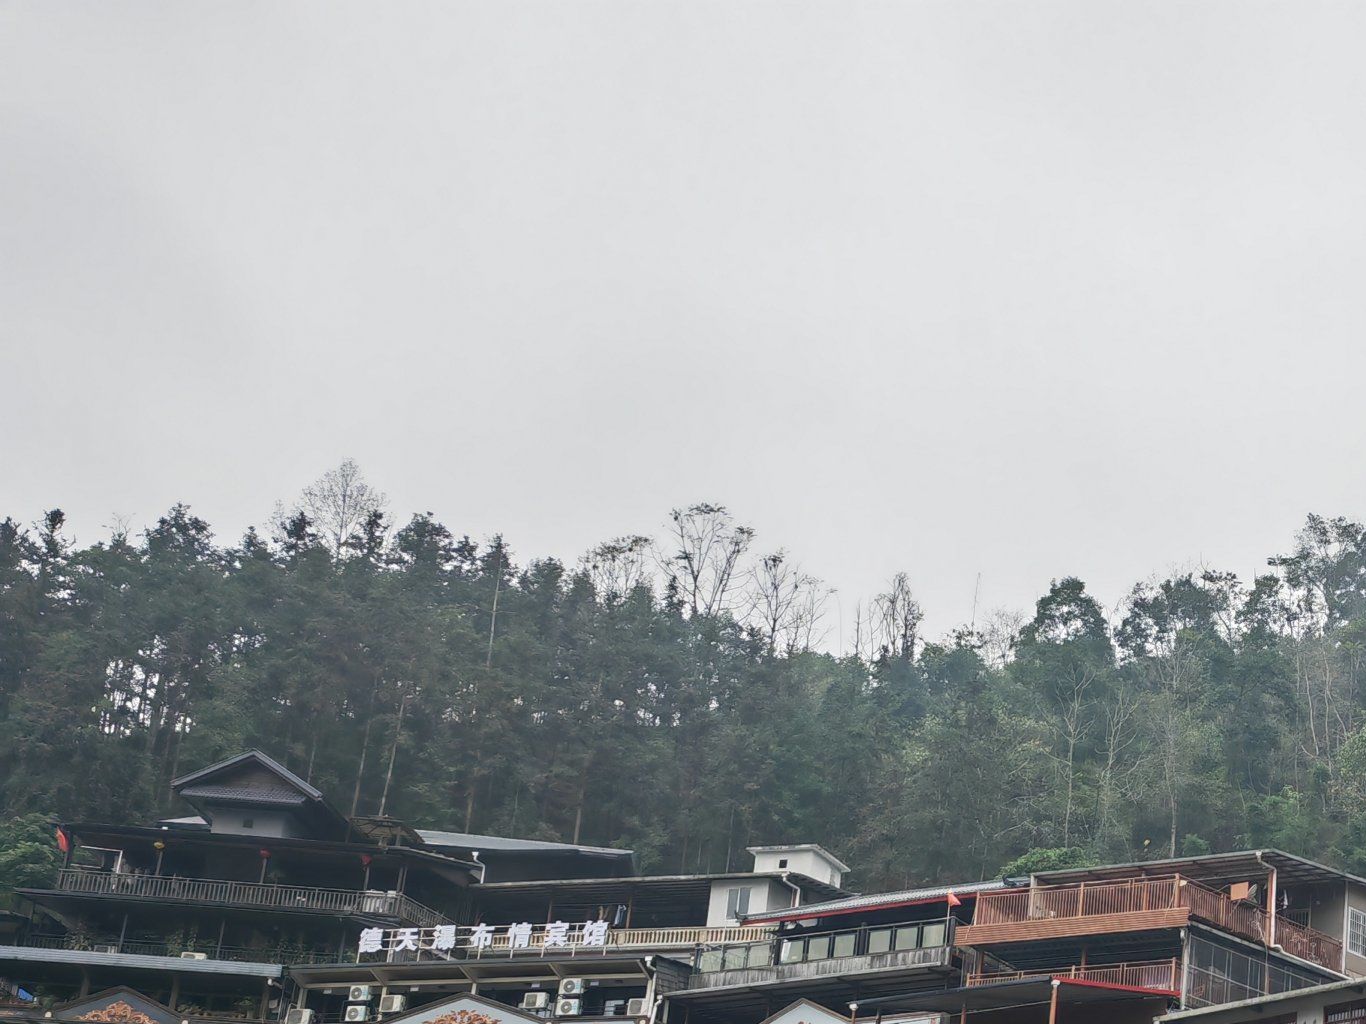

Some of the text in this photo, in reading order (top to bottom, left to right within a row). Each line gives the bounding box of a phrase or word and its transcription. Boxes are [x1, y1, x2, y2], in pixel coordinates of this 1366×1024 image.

[358, 918, 610, 954] 德天瀑布情宾馆
